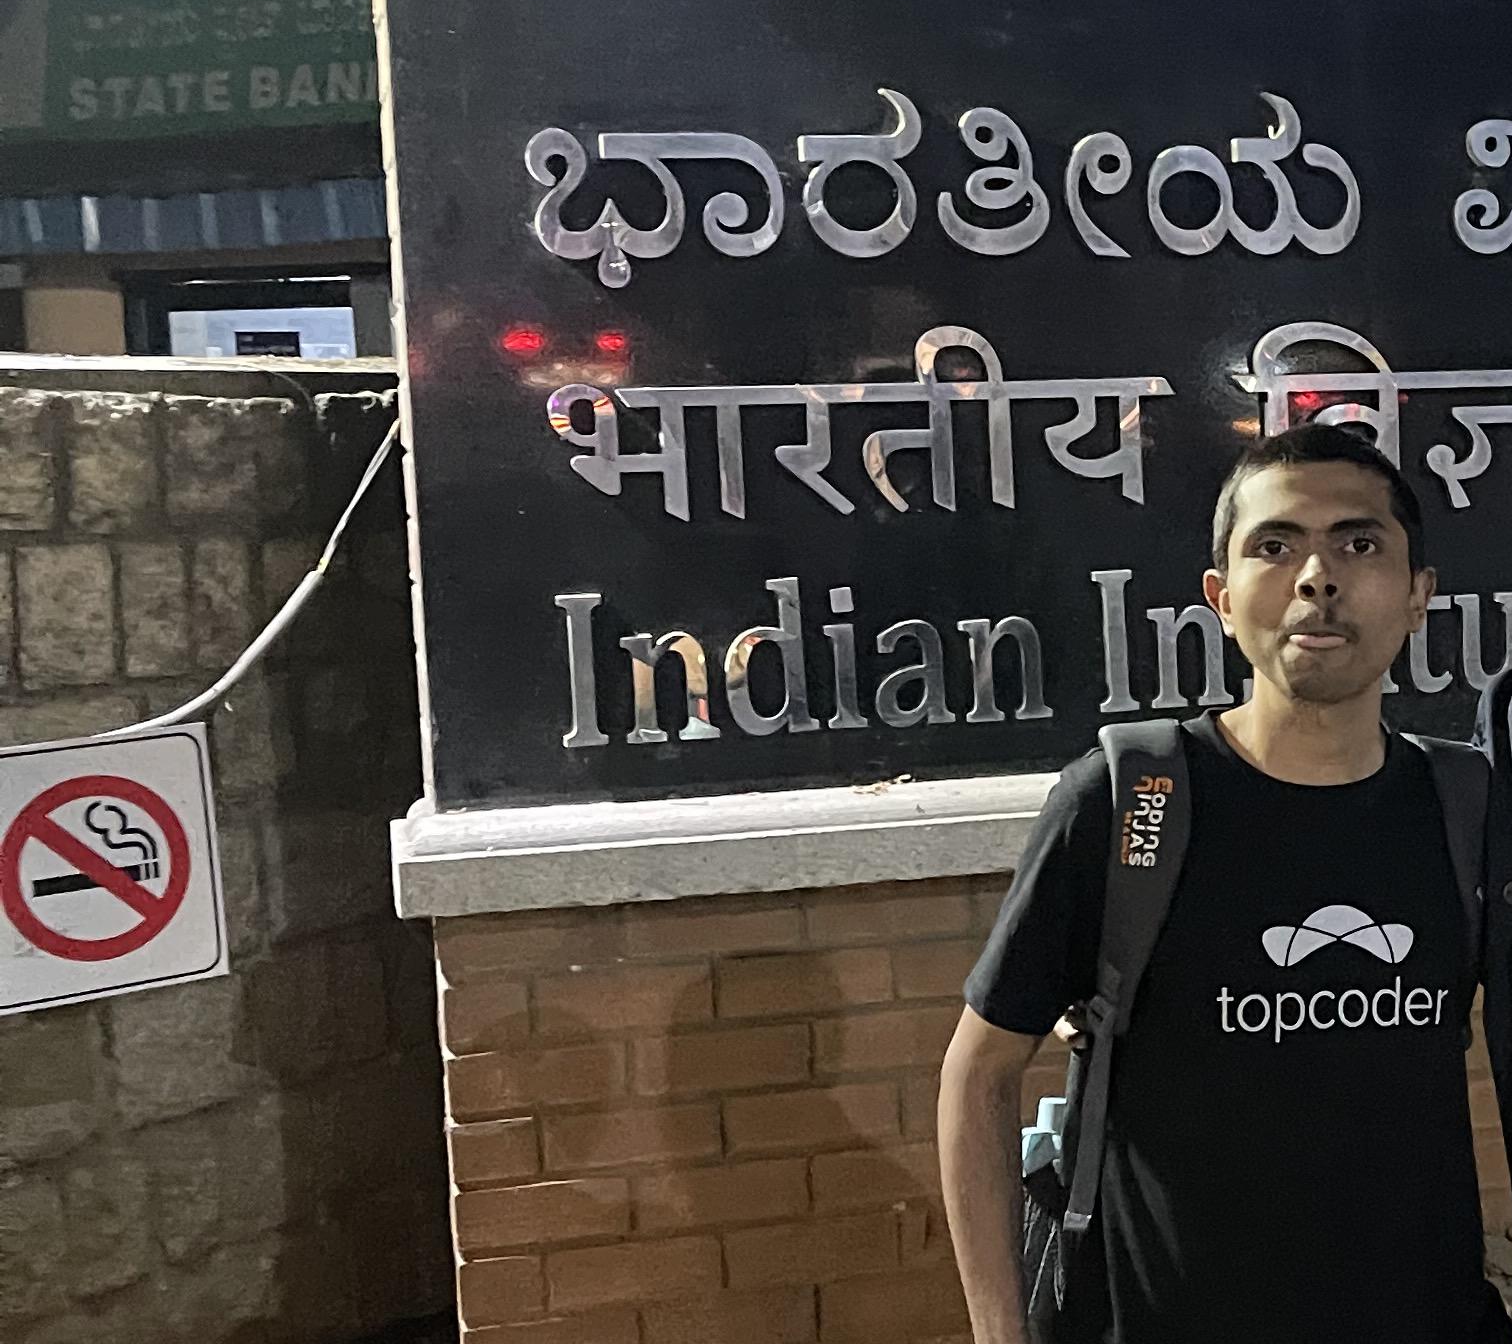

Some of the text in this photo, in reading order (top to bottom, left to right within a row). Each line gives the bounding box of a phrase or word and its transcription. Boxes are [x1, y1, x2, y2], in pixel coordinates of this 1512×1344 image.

[69, 70, 233, 123] STATE
[524, 87, 1362, 289] ಭಾರತೀಯ
[545, 324, 1176, 523] भारतीय
[553, 576, 1053, 749] Indian
[1216, 976, 1449, 1044] topcoder
